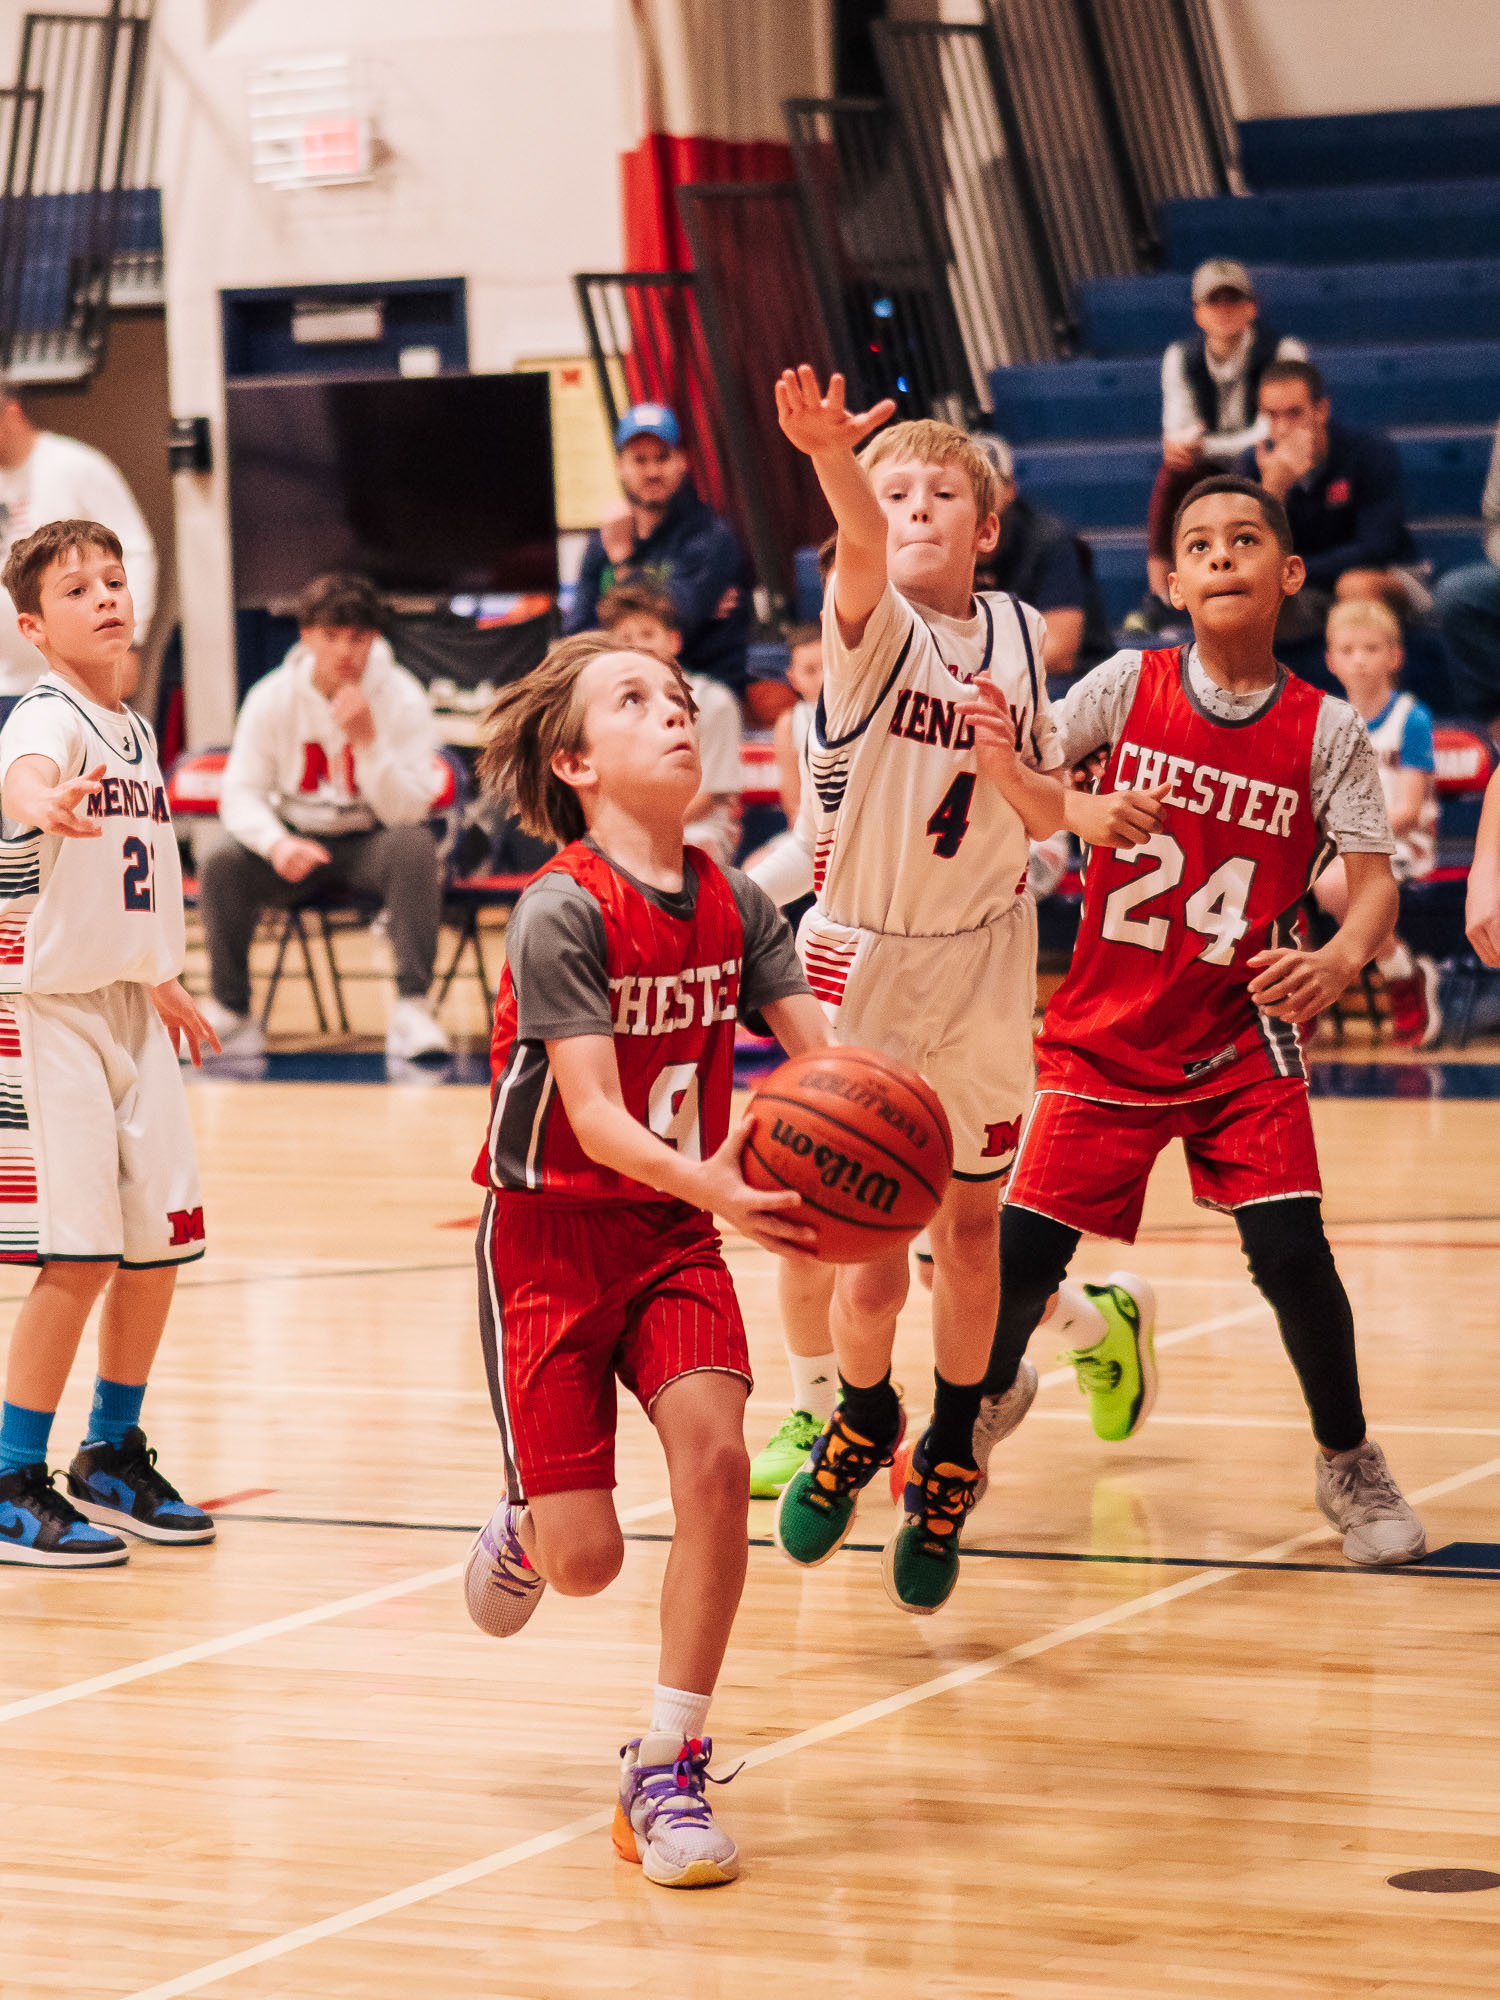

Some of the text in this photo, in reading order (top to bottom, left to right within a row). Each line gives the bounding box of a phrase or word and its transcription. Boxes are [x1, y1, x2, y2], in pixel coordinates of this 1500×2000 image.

[926, 771, 977, 859] 4
[1113, 741, 1300, 838] CHESTER
[122, 836, 156, 913] 2
[1100, 832, 1258, 967] 24
[608, 957, 742, 1036] HESTE
[770, 1117, 902, 1214] Wilson
[980, 1113, 1022, 1157] M
[167, 1206, 206, 1246] M
